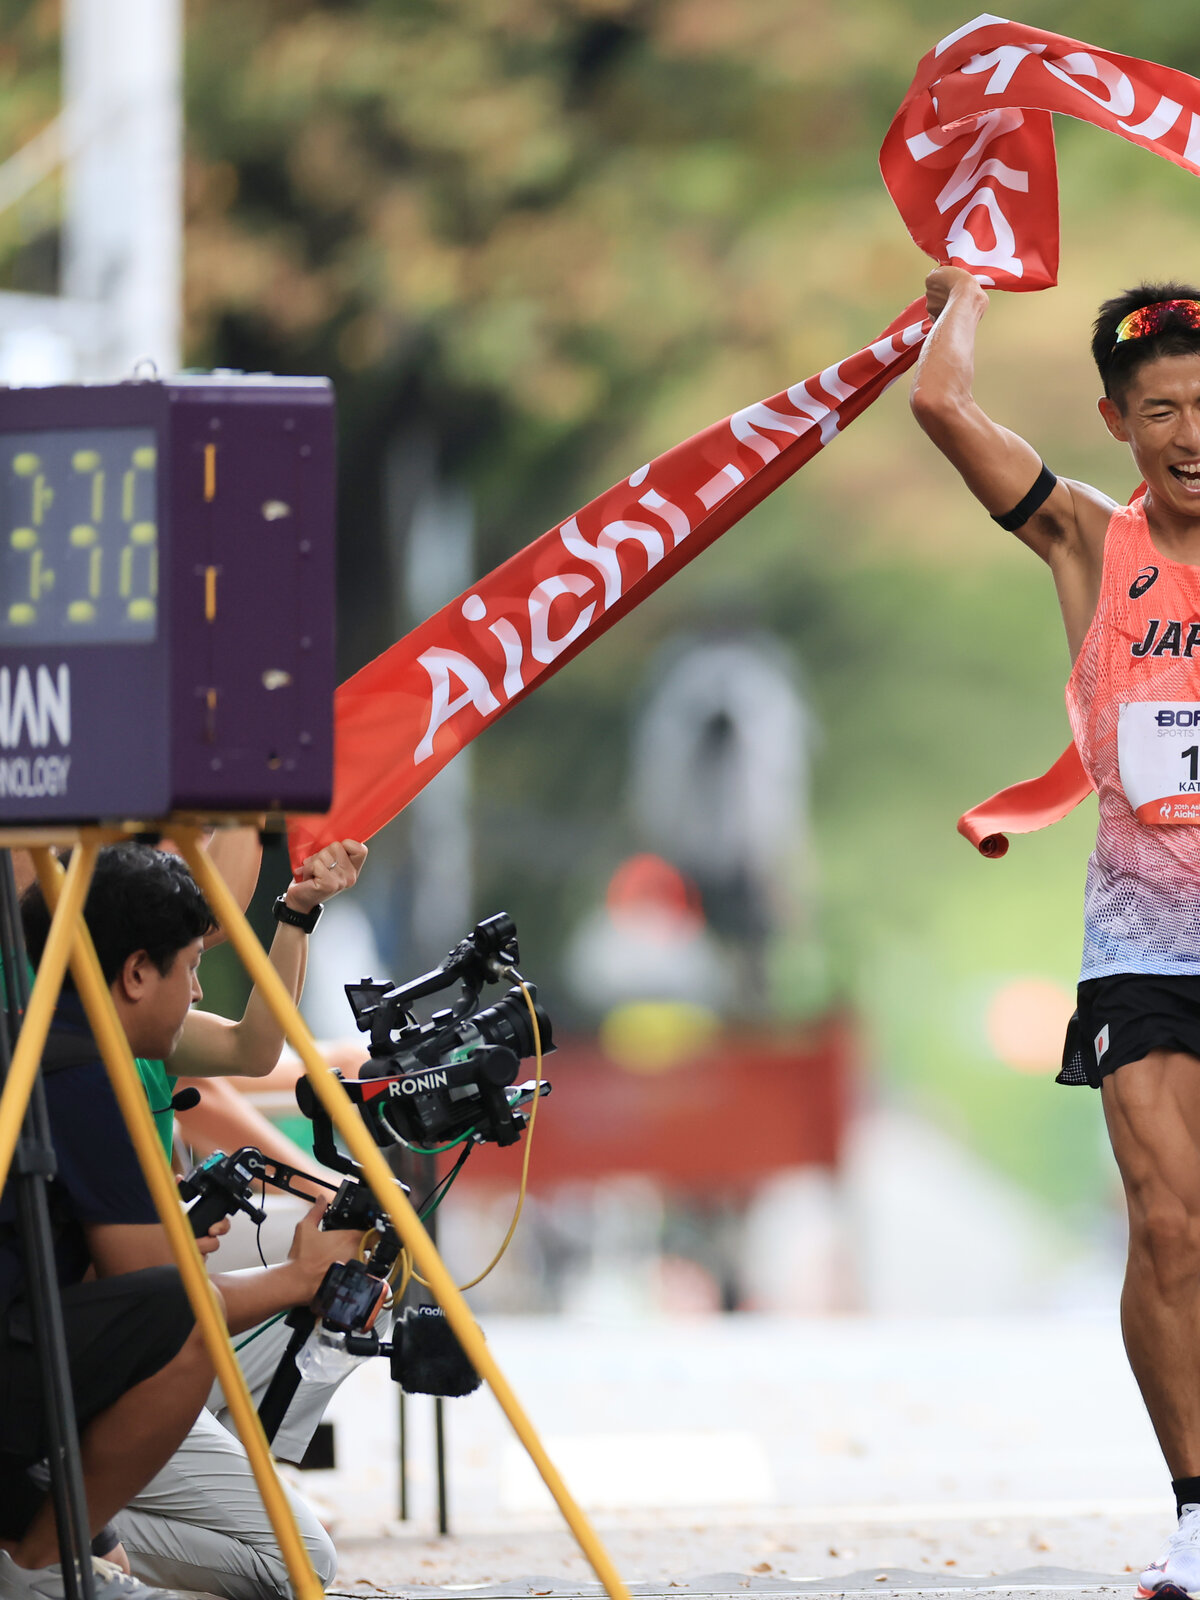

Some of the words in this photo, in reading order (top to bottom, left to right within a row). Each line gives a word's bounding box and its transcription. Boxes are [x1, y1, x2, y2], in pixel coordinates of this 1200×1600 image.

[1157, 729, 1194, 737] SPORTS
[388, 1070, 448, 1097] RONIN
[419, 1306, 446, 1317] radi
